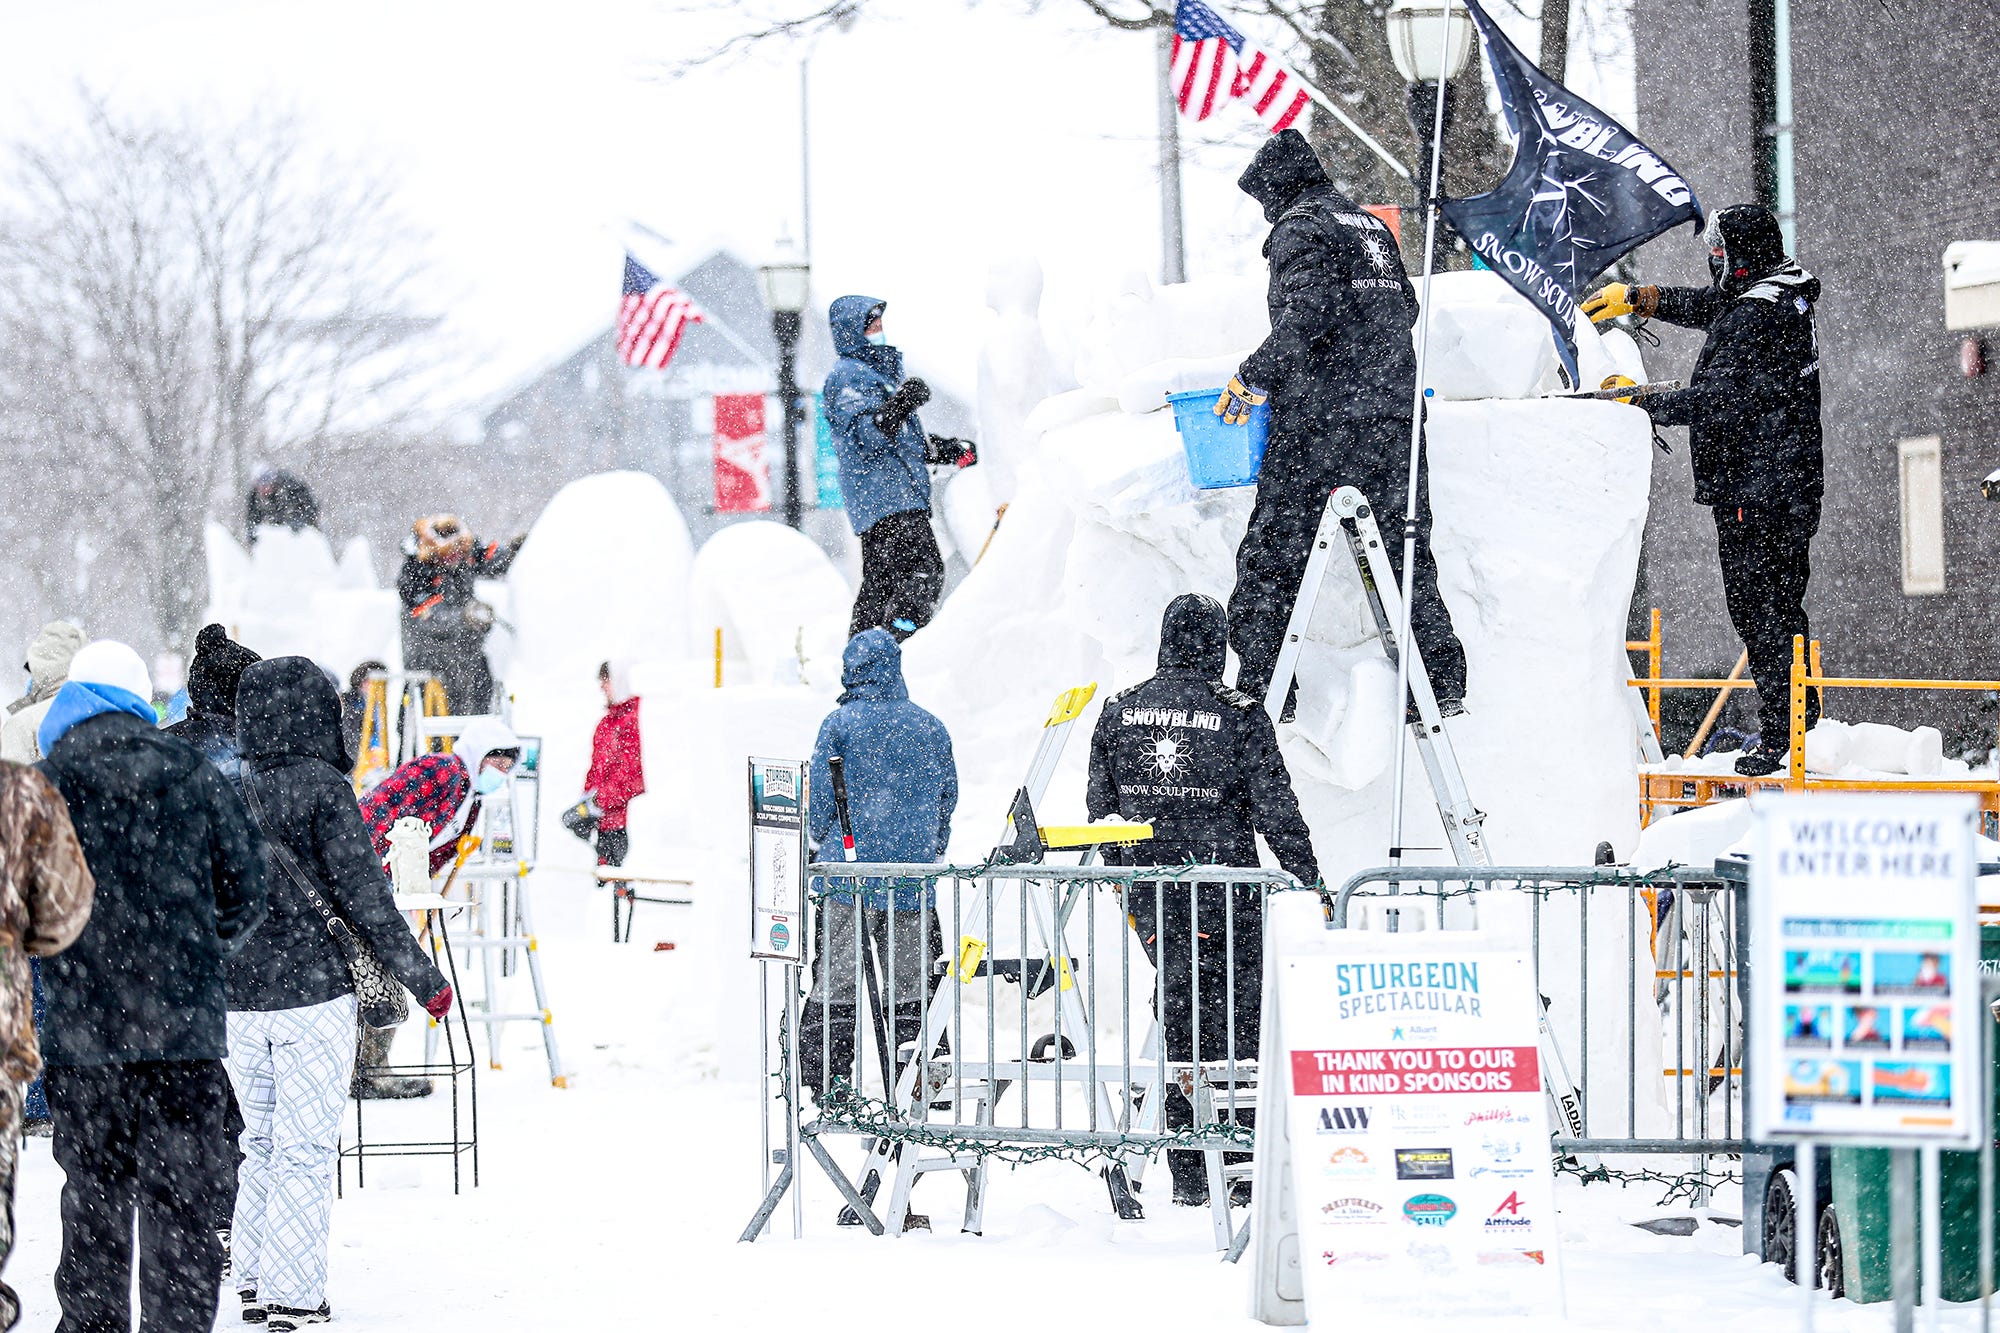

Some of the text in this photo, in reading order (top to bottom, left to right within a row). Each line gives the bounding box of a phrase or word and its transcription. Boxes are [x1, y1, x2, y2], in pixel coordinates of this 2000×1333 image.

[1473, 232, 1545, 285] SNOW
[1352, 279, 1376, 289] SNOW
[1121, 707, 1222, 732] SNOWBLIND
[1120, 785, 1219, 798] SNOW SCULPTING
[1789, 819, 1941, 847] WELCOME
[1778, 851, 1955, 878] ENTER HERE
[1336, 962, 1479, 996] STURGEON
[1977, 959, 2000, 977] 267
[1339, 991, 1482, 1019] SPECTACULAR
[1313, 1050, 1516, 1071] THANK YOU TO OUR
[1321, 1071, 1512, 1093] IN KIND SPONSORS
[1464, 1105, 1511, 1127] Philly's
[1561, 1094, 1582, 1139] LADD
[1417, 1217, 1443, 1225] CAFE
[1485, 1217, 1531, 1226] Attitude
